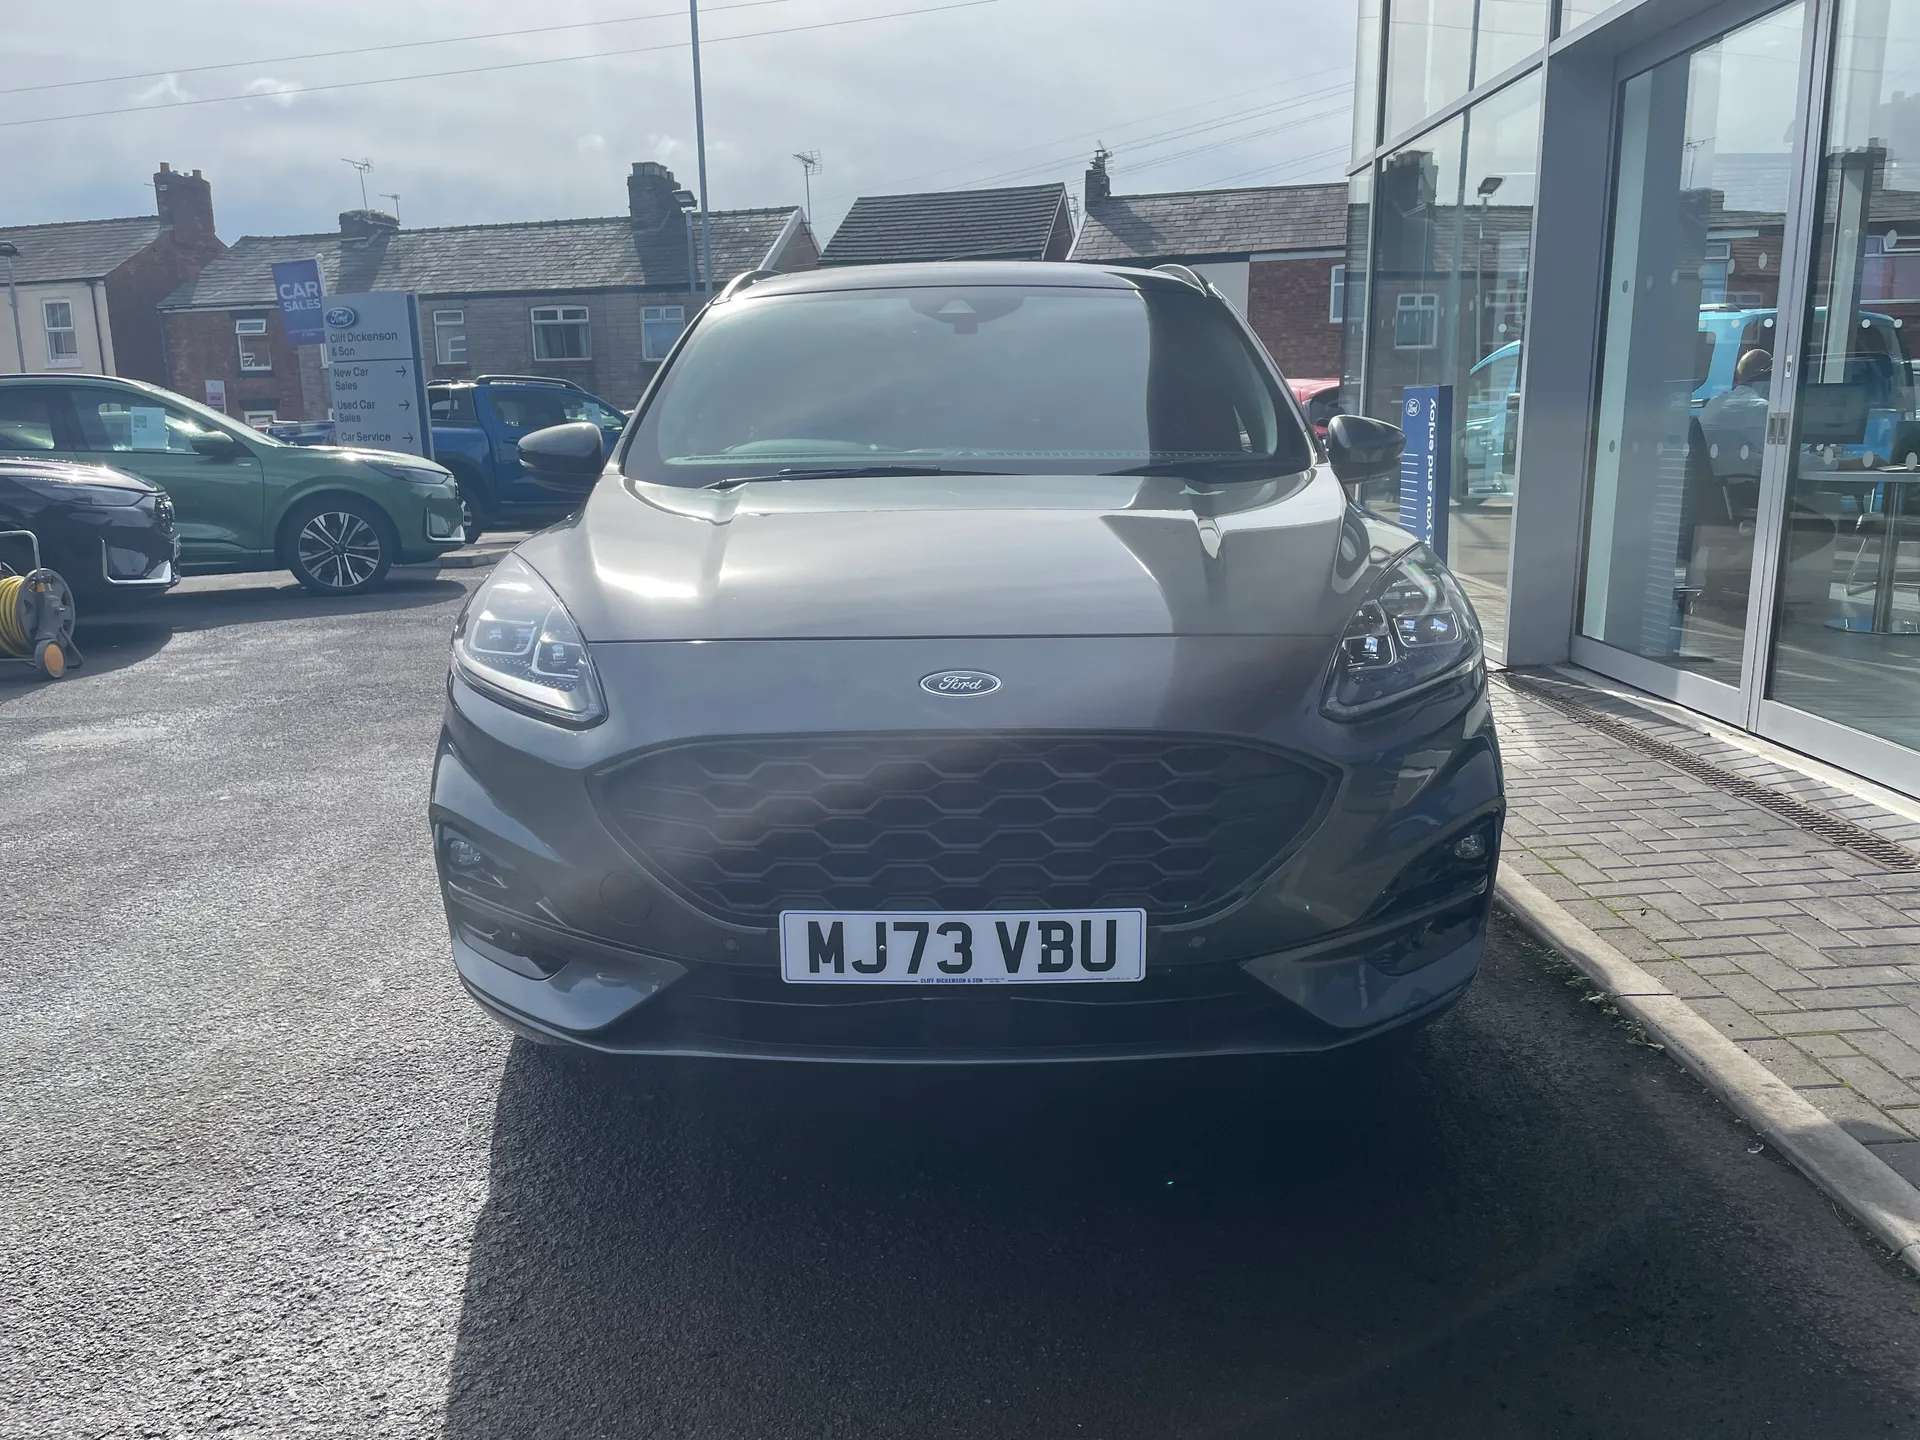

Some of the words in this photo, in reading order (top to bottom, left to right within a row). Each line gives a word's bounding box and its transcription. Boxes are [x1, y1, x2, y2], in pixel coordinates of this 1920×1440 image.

[280, 281, 318, 299] CAR
[284, 299, 320, 311] SALES
[348, 331, 398, 341] Dickenson
[339, 346, 355, 356] Son
[334, 368, 351, 377] New
[353, 367, 368, 376] Car
[336, 381, 357, 391] Sales
[338, 400, 357, 410] Used
[360, 400, 375, 409] Car
[340, 413, 361, 423] Sales
[1428, 398, 1436, 451] enjoy
[342, 432, 355, 442] Car
[357, 432, 391, 442] Service
[807, 920, 973, 974] MJ73
[995, 919, 1117, 974] VBU
